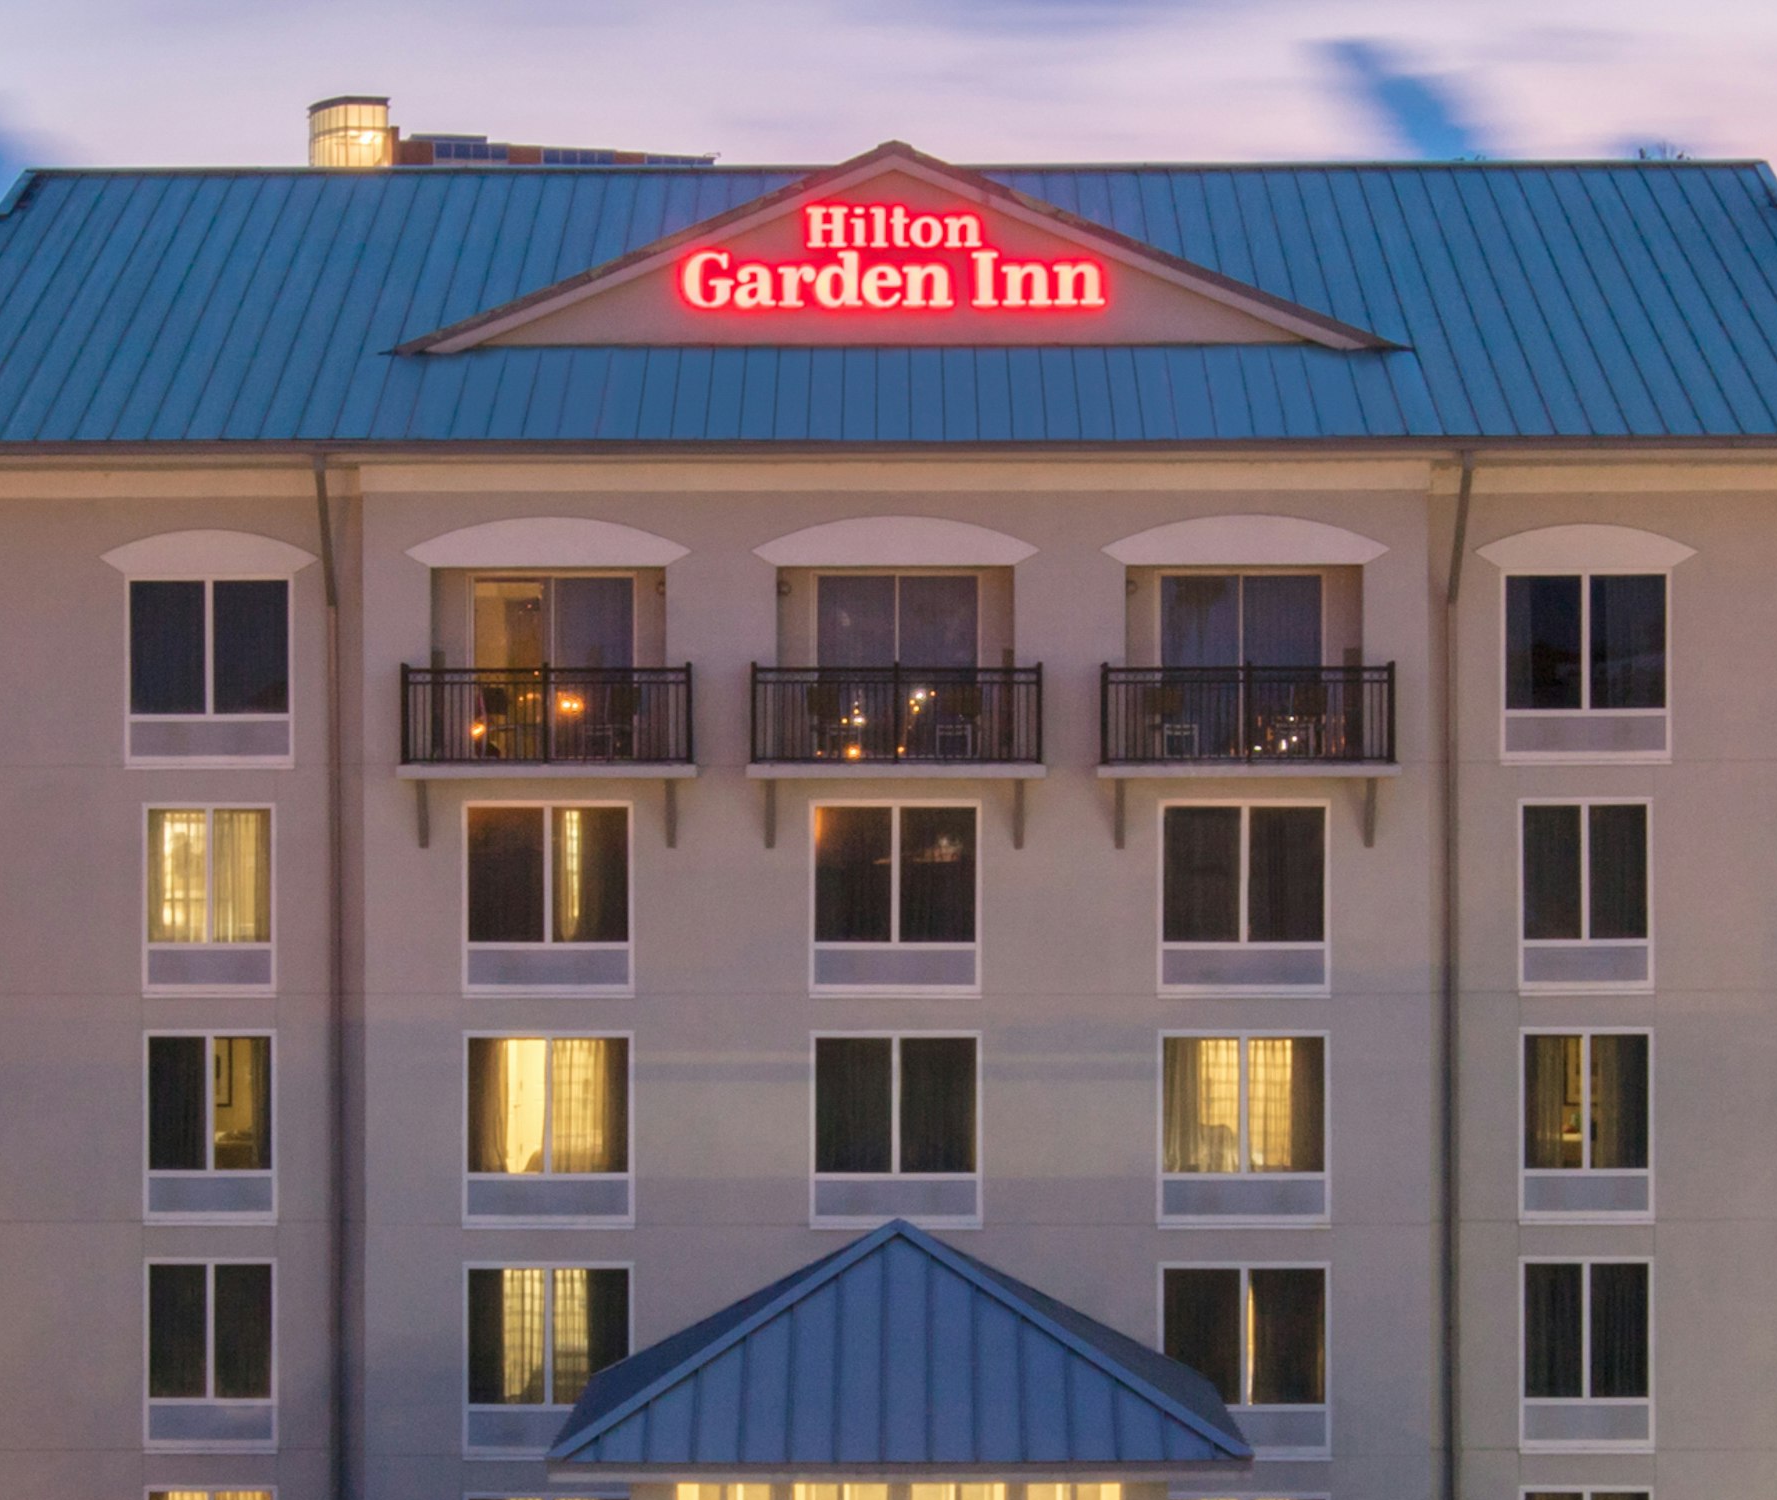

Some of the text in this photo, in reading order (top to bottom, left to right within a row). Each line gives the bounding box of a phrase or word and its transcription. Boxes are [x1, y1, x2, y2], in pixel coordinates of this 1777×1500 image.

[806, 206, 982, 248] Hilton
[683, 251, 1105, 308] Garden Inn
